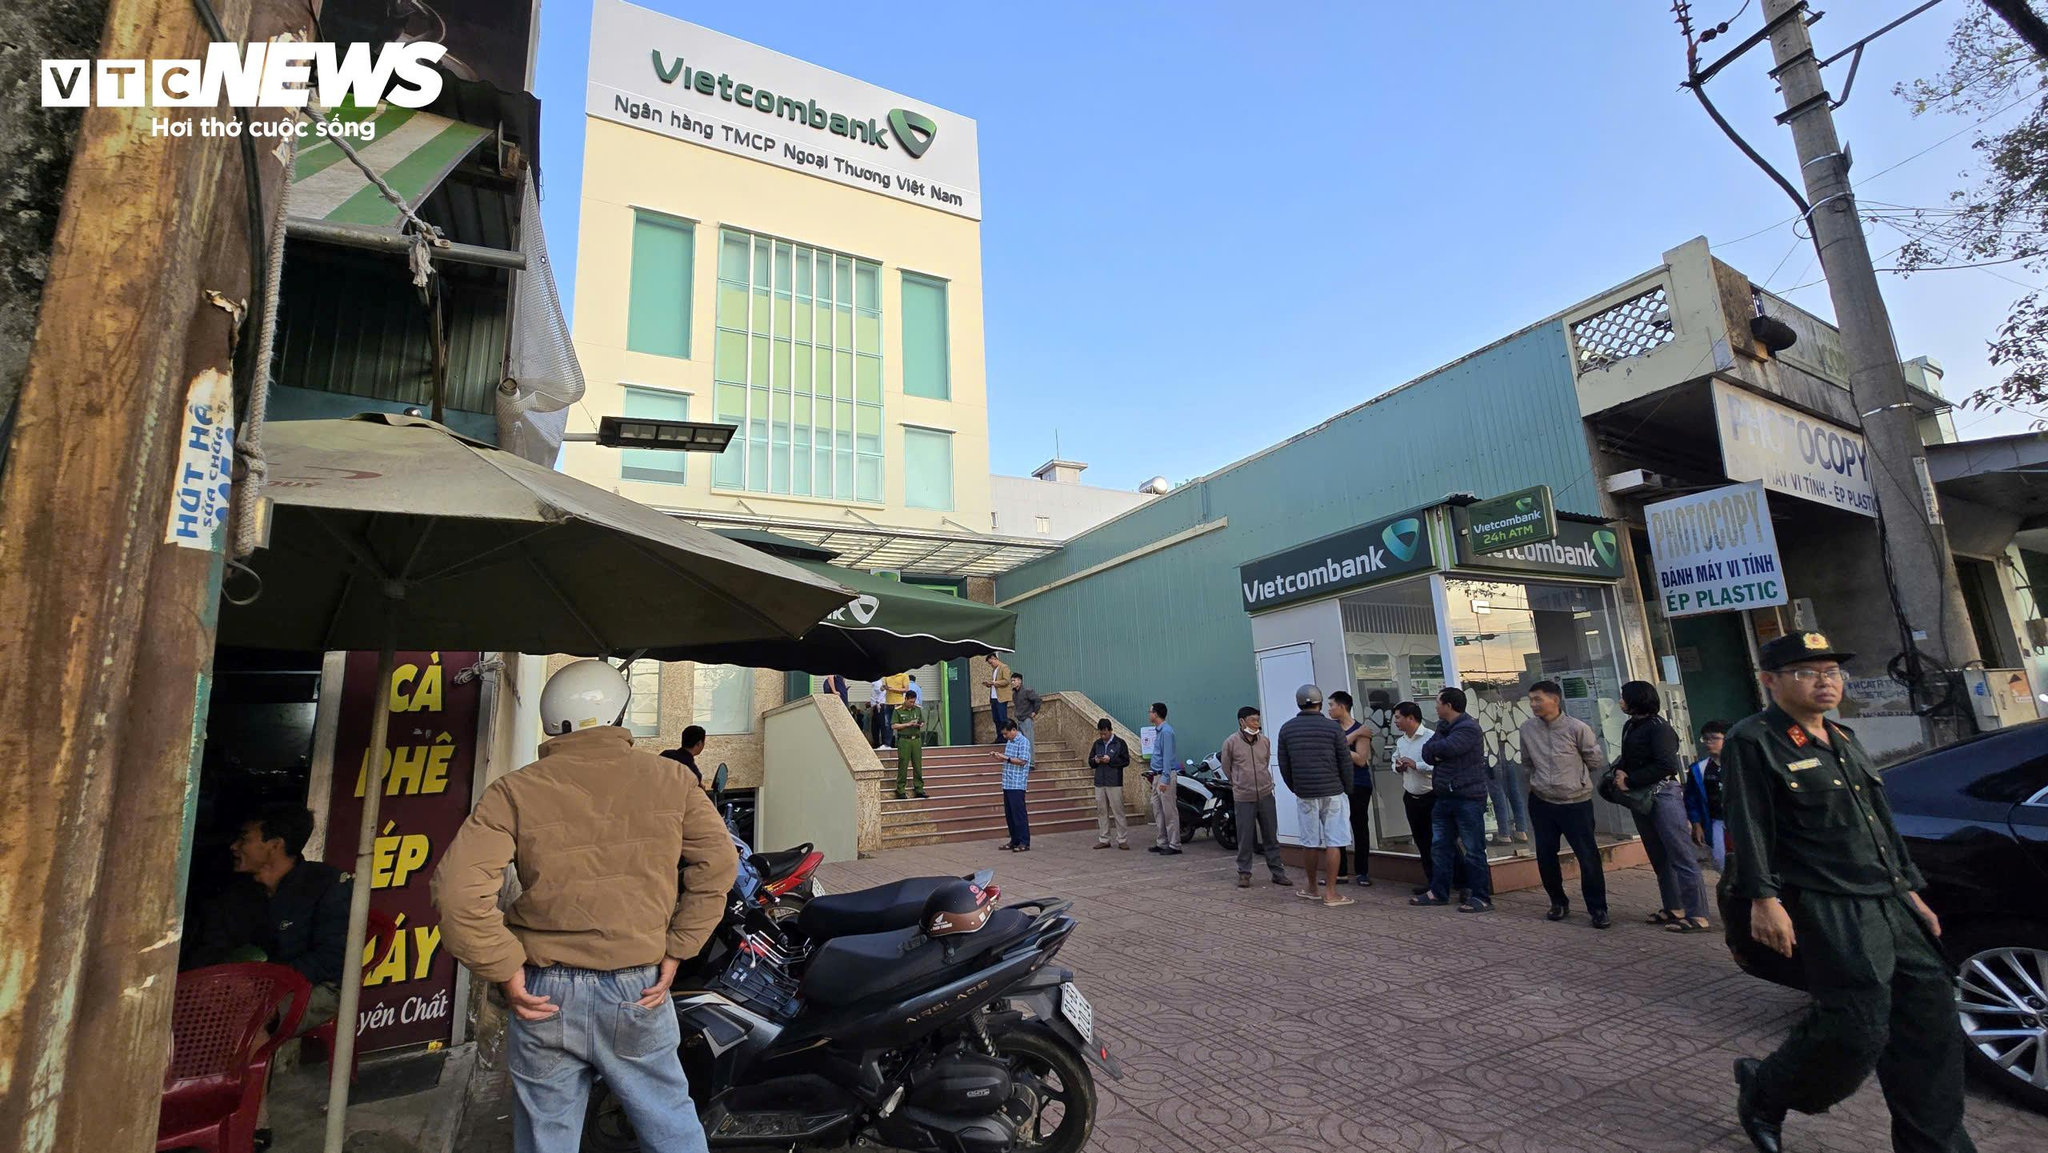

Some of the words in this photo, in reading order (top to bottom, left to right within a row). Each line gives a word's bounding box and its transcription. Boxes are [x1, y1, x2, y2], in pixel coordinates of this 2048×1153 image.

[651, 49, 889, 150] Vietcombank
[614, 94, 662, 123] Ngân
[671, 110, 713, 139] hàng
[721, 125, 776, 152] TMCP
[784, 144, 828, 170] Ngoại
[834, 157, 890, 189] Thương
[896, 175, 925, 197] Việt
[930, 185, 963, 206] Nam
[1727, 394, 1868, 482] PHOTOCOPY
[176, 462, 204, 538] HÚT
[1790, 474, 1803, 492] VI
[1803, 473, 1827, 498] TÍNH
[1834, 481, 1846, 503] ÉP
[1473, 509, 1541, 534] Vietcombank
[1483, 531, 1507, 544] 24h
[1508, 525, 1534, 539] ATM
[1651, 490, 1764, 561] PHOTOCOPY
[1243, 545, 1386, 603] Vietcombank
[1661, 566, 1694, 588] ĐÁNH
[1696, 559, 1723, 582] MÁY
[1727, 560, 1741, 578] VI
[1742, 552, 1775, 576] TÍNH
[1666, 590, 1690, 612] ÉP
[1696, 580, 1778, 608] PLASTIC
[389, 653, 442, 713] CÀ
[400, 989, 449, 1024] Chất
